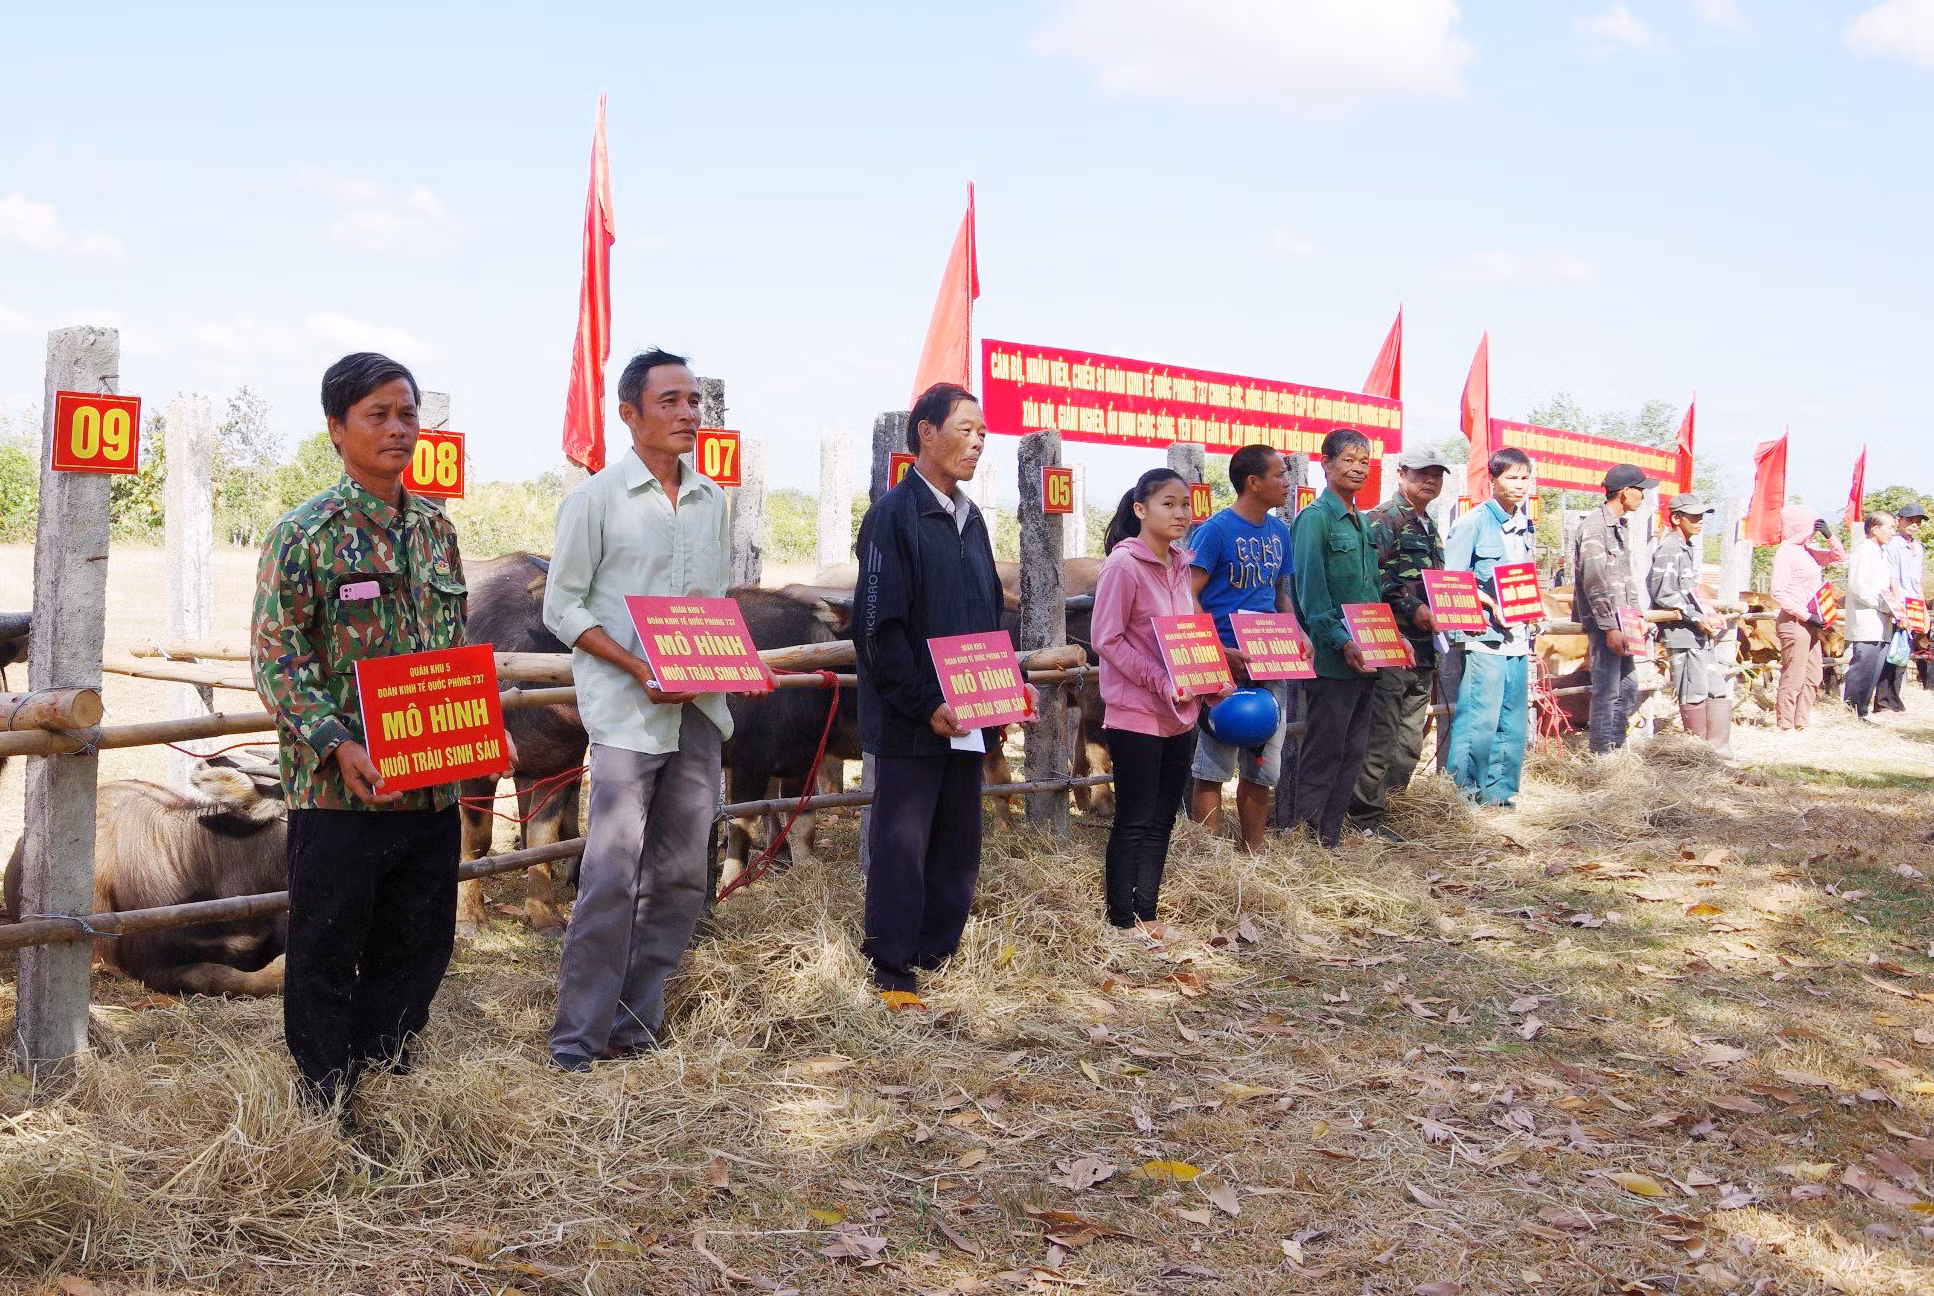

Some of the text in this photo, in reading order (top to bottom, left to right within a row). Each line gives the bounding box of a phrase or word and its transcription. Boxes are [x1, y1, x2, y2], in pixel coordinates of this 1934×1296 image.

[1195, 381, 1207, 404] 737
[71, 405, 130, 461] 09
[412, 439, 458, 487] 08
[704, 437, 736, 477] 07
[1048, 474, 1070, 506] 05
[1193, 489, 1210, 517] 04
[700, 606, 706, 615] 5
[1434, 591, 1477, 609] MÔ HÌNH
[665, 617, 680, 625] KINH
[725, 618, 736, 627] 737
[1357, 625, 1398, 644] MÔ HÌNH
[653, 630, 748, 657] MÔ HÌNH
[1169, 642, 1221, 666] MÔ HÌNH
[1246, 637, 1300, 656] MÔ HÌNH
[409, 662, 451, 678] QUÂN KHU 5
[660, 661, 764, 681] NUÔI TRÂU SINH SẢN
[949, 666, 1017, 695] MÔ HÌNH
[377, 674, 485, 699] ĐOÀN KINH TẾ QUỐC PHÒNG 737
[381, 696, 490, 742] MÔ HÌNH
[954, 692, 1028, 720] NUÔI TRÂU SINH SẢN
[379, 734, 501, 779] NUÔI TRÂU SINH SẢN
